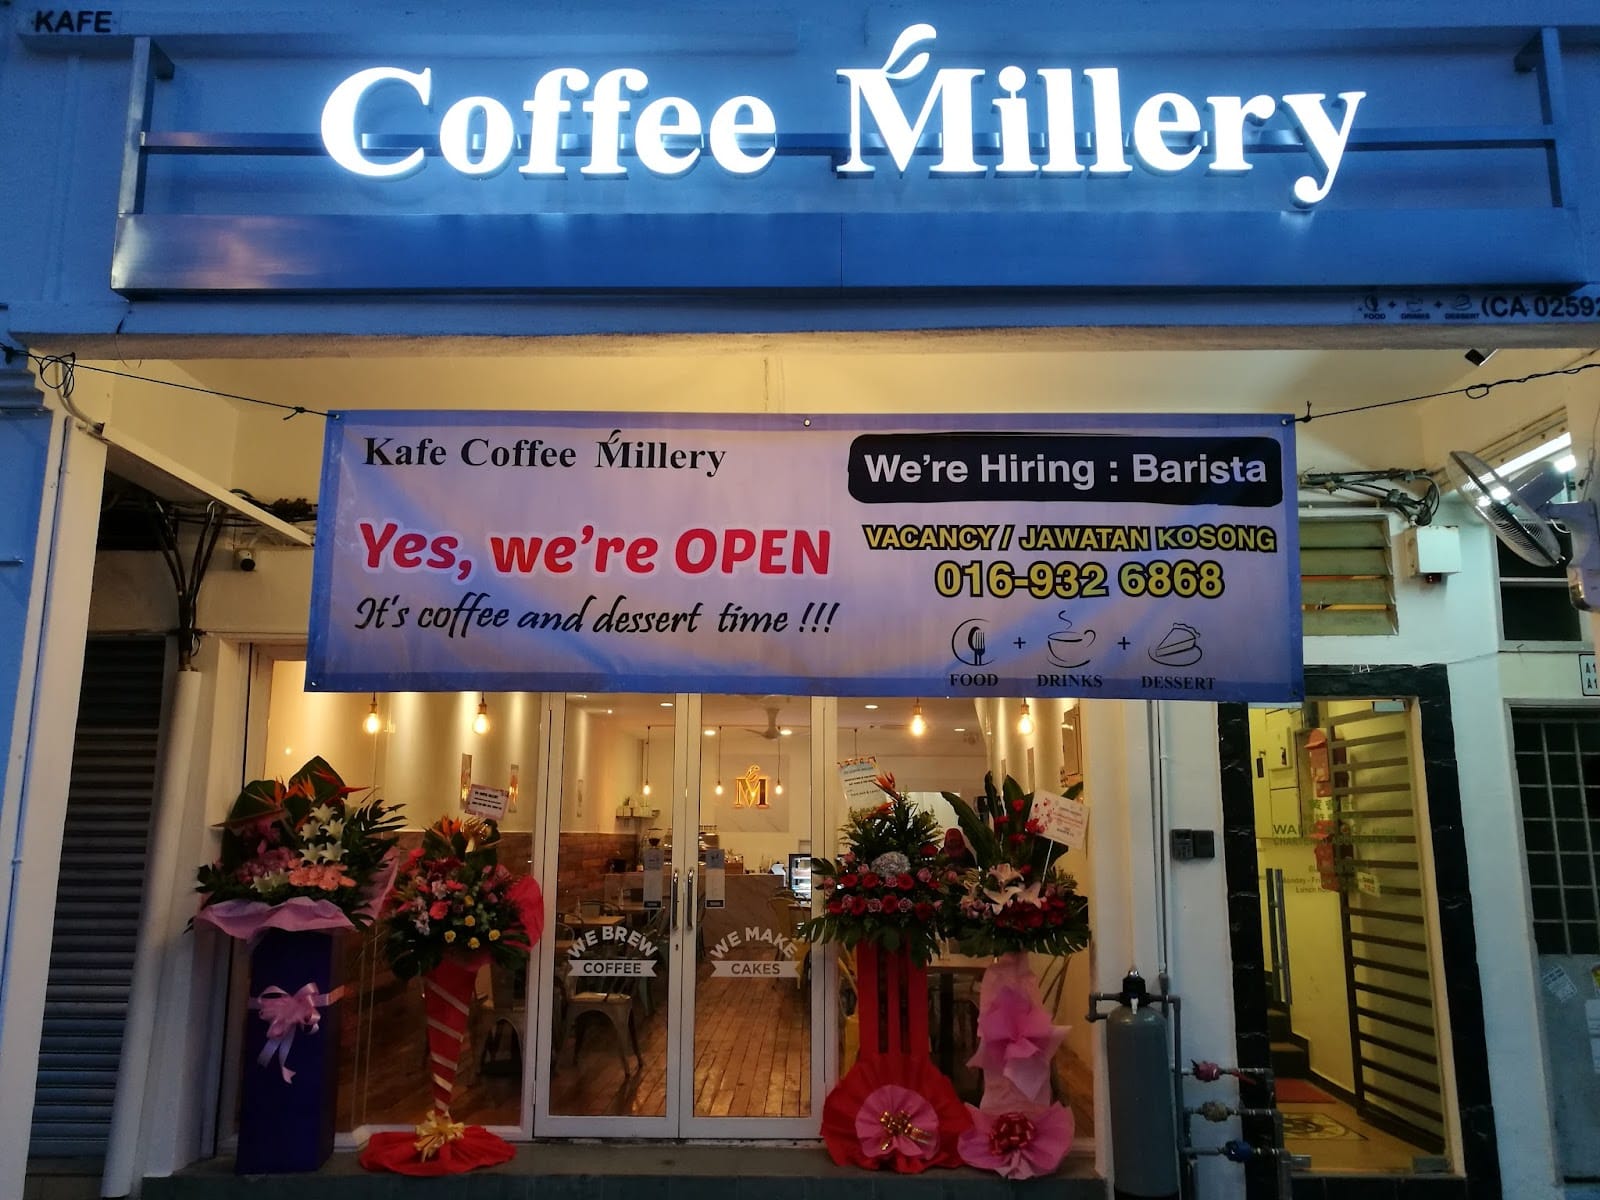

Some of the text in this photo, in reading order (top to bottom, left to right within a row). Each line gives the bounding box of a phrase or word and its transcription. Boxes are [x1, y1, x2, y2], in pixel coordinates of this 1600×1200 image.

[35, 10, 112, 33] KAFE
[320, 64, 1367, 204] Coffee Millery
[1482, 296, 1527, 317] (CA
[364, 436, 727, 477] Kafe Coffee Millery
[864, 453, 1267, 491] We're Hiring : Barista
[359, 522, 831, 581] Yes, we're OPEN
[863, 524, 1277, 553] VACANCY / JAWATAN KOSONG
[934, 560, 1224, 598] 016-932 6868
[354, 591, 840, 638] It's coffee and dessert time !!!
[949, 673, 1216, 691] FOOD DRINKS DESSERT
[568, 925, 659, 960] WE BREW
[710, 926, 799, 960] WE MAKE
[583, 962, 641, 974] COFFEE
[731, 963, 781, 975] CAKES
